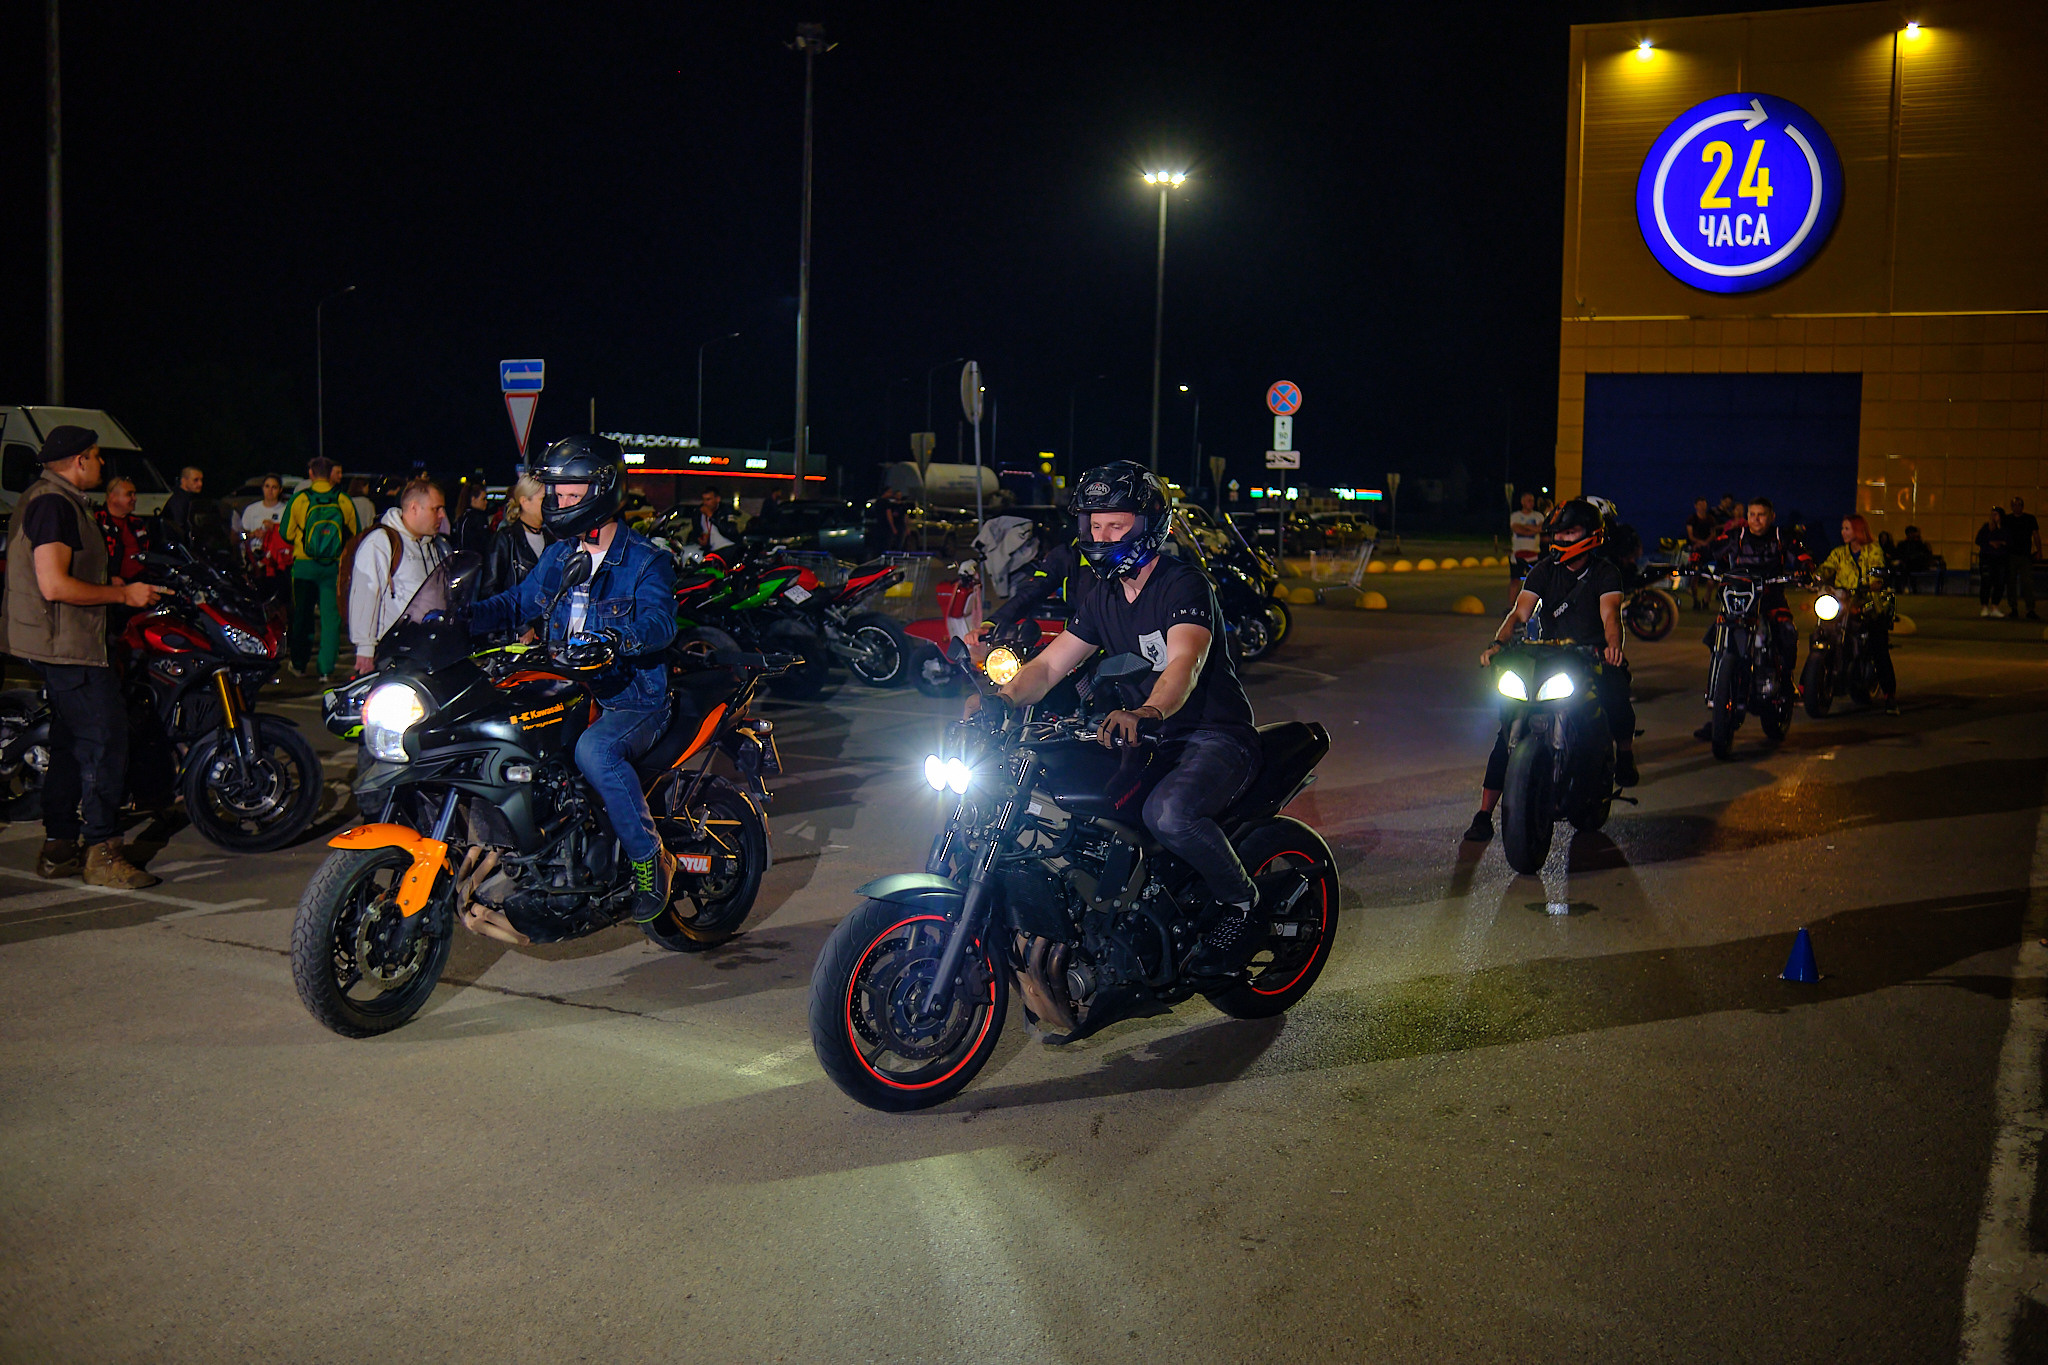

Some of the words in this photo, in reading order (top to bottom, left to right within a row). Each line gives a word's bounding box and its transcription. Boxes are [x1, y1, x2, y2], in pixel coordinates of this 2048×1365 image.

[1700, 139, 1773, 209] 24
[1699, 213, 1771, 247] ЧАСА
[530, 701, 565, 719] Kawasaki
[677, 857, 709, 872] OTUL
